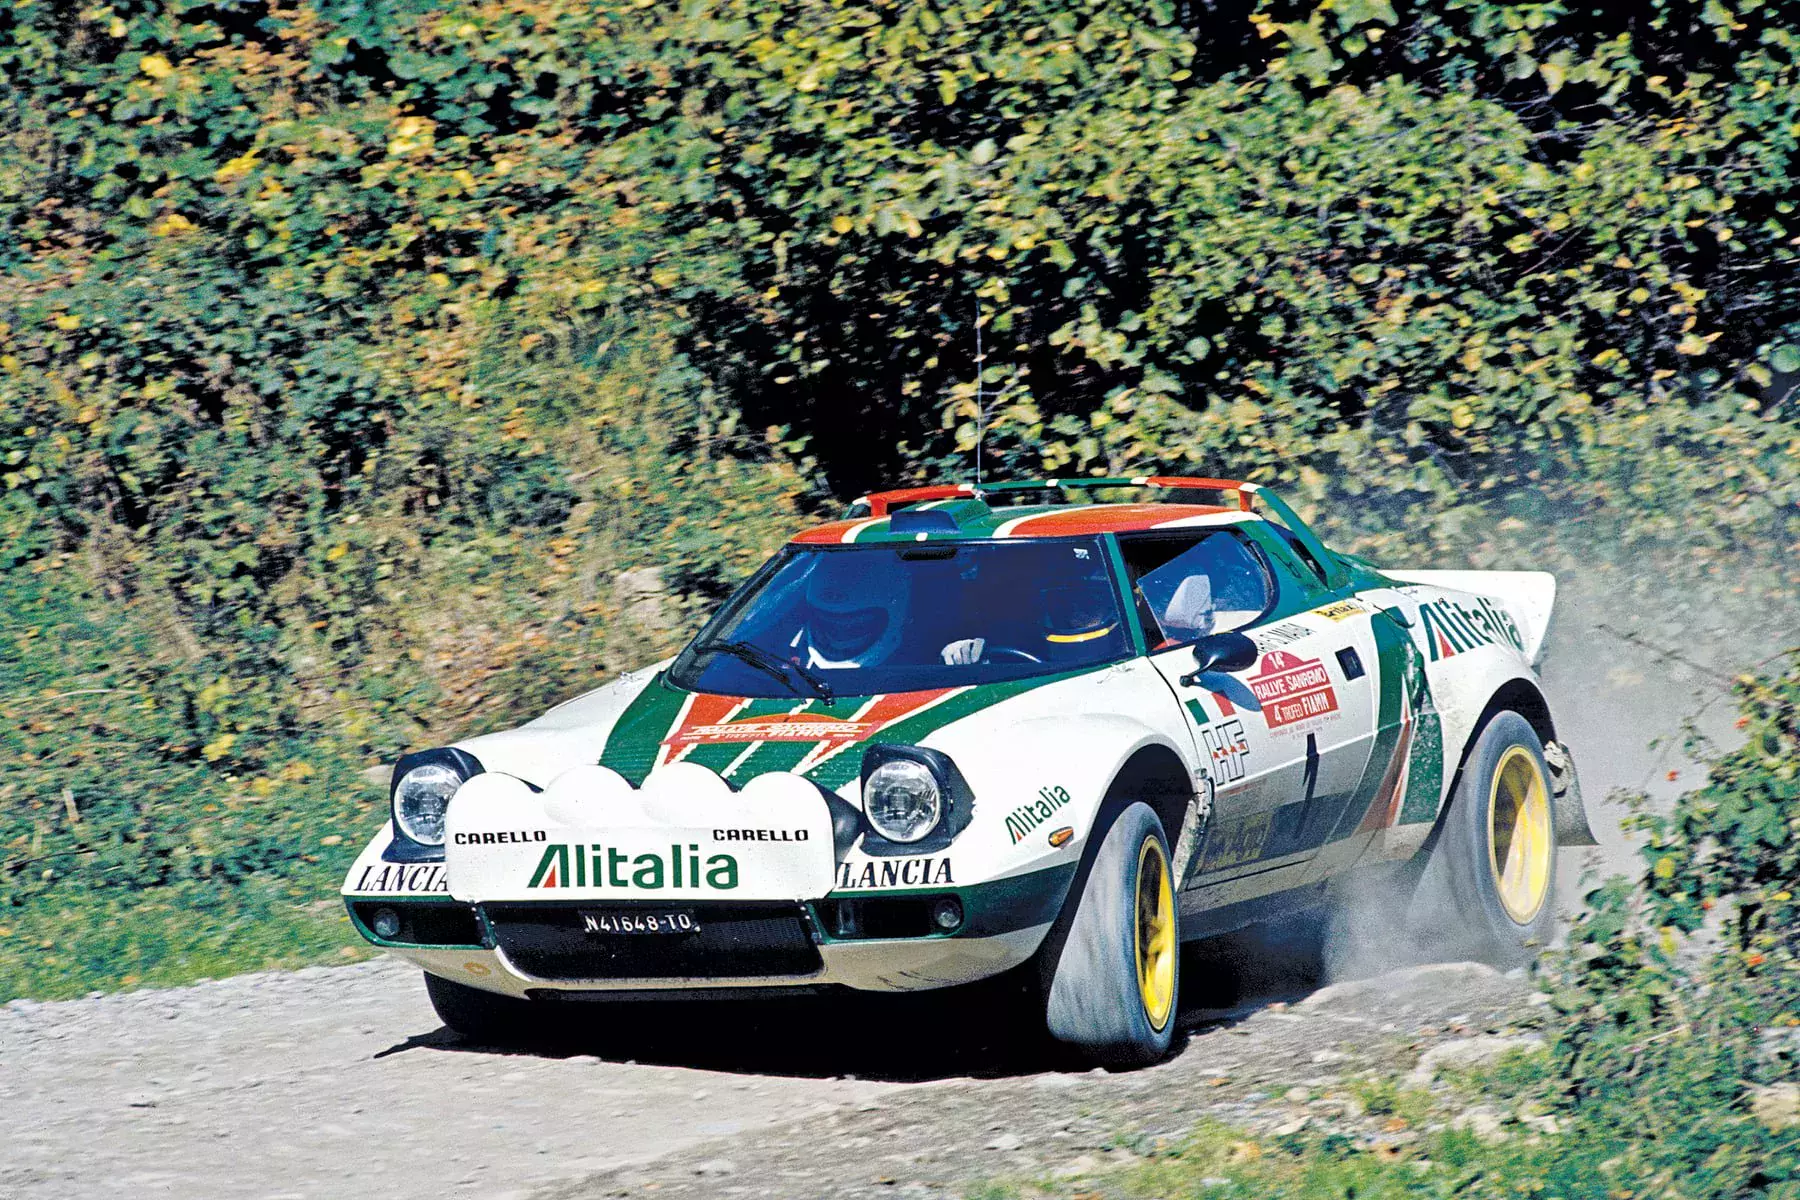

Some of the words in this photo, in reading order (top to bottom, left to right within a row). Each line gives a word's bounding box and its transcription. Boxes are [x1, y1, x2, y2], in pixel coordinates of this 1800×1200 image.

[1419, 597, 1525, 662] Alitalia
[1254, 678, 1287, 701] RALLYE
[1285, 667, 1327, 691] SANREMO
[1202, 719, 1250, 787] HF
[1005, 786, 1071, 845] Alitalia
[454, 830, 547, 845] CARELLO
[712, 828, 809, 842] CARELLO
[353, 865, 449, 892] LANCIA
[527, 844, 739, 890] Alitalia
[838, 857, 955, 889] LANCIA
